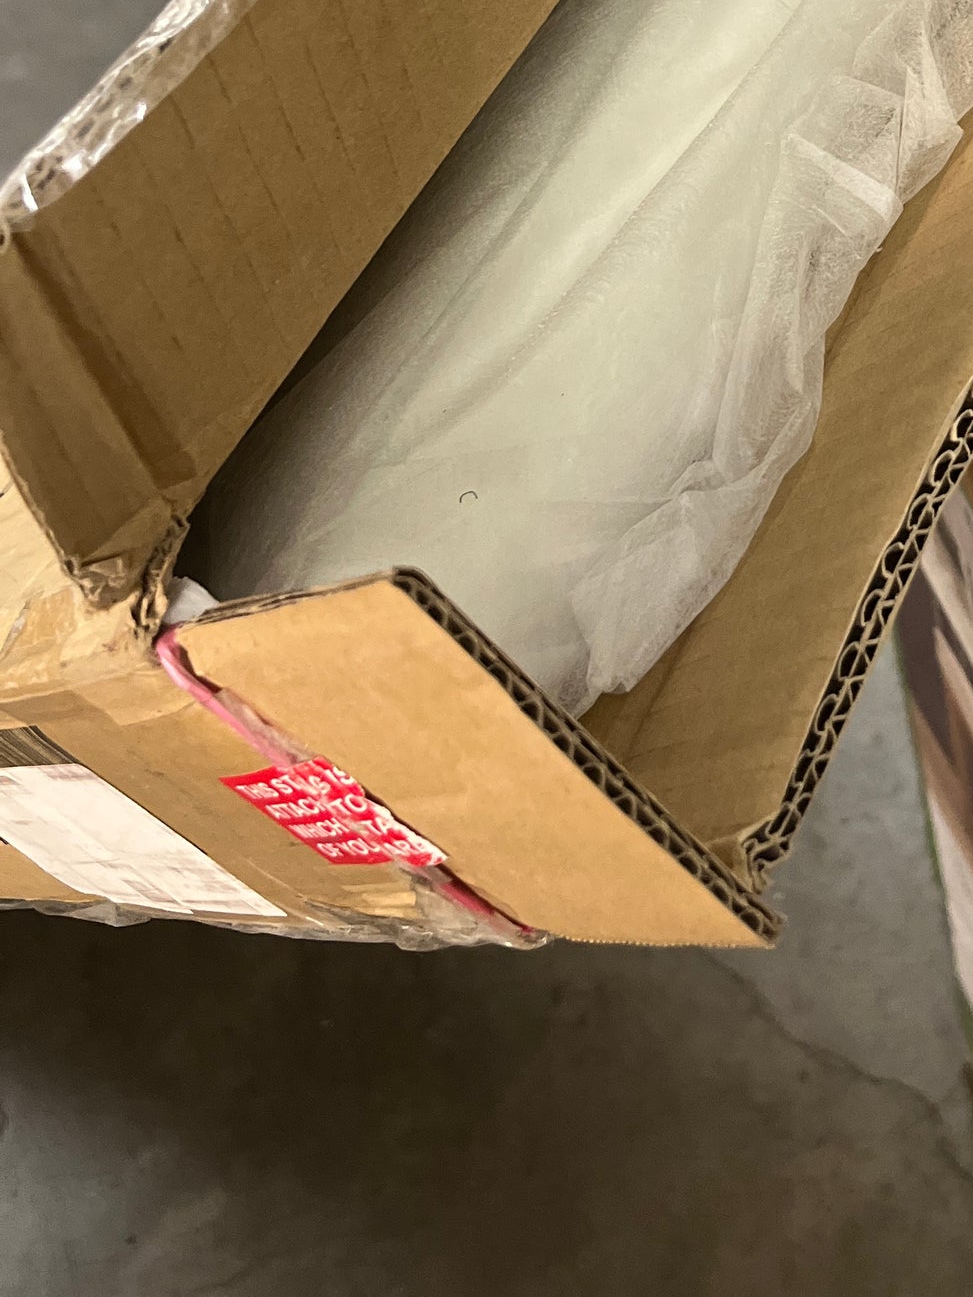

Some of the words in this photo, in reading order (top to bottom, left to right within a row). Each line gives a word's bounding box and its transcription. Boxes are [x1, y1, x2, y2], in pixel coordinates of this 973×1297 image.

[236, 782, 279, 799] THIS
[333, 793, 367, 815] TO
[288, 817, 349, 838] WHICH
[317, 842, 343, 857] OF
